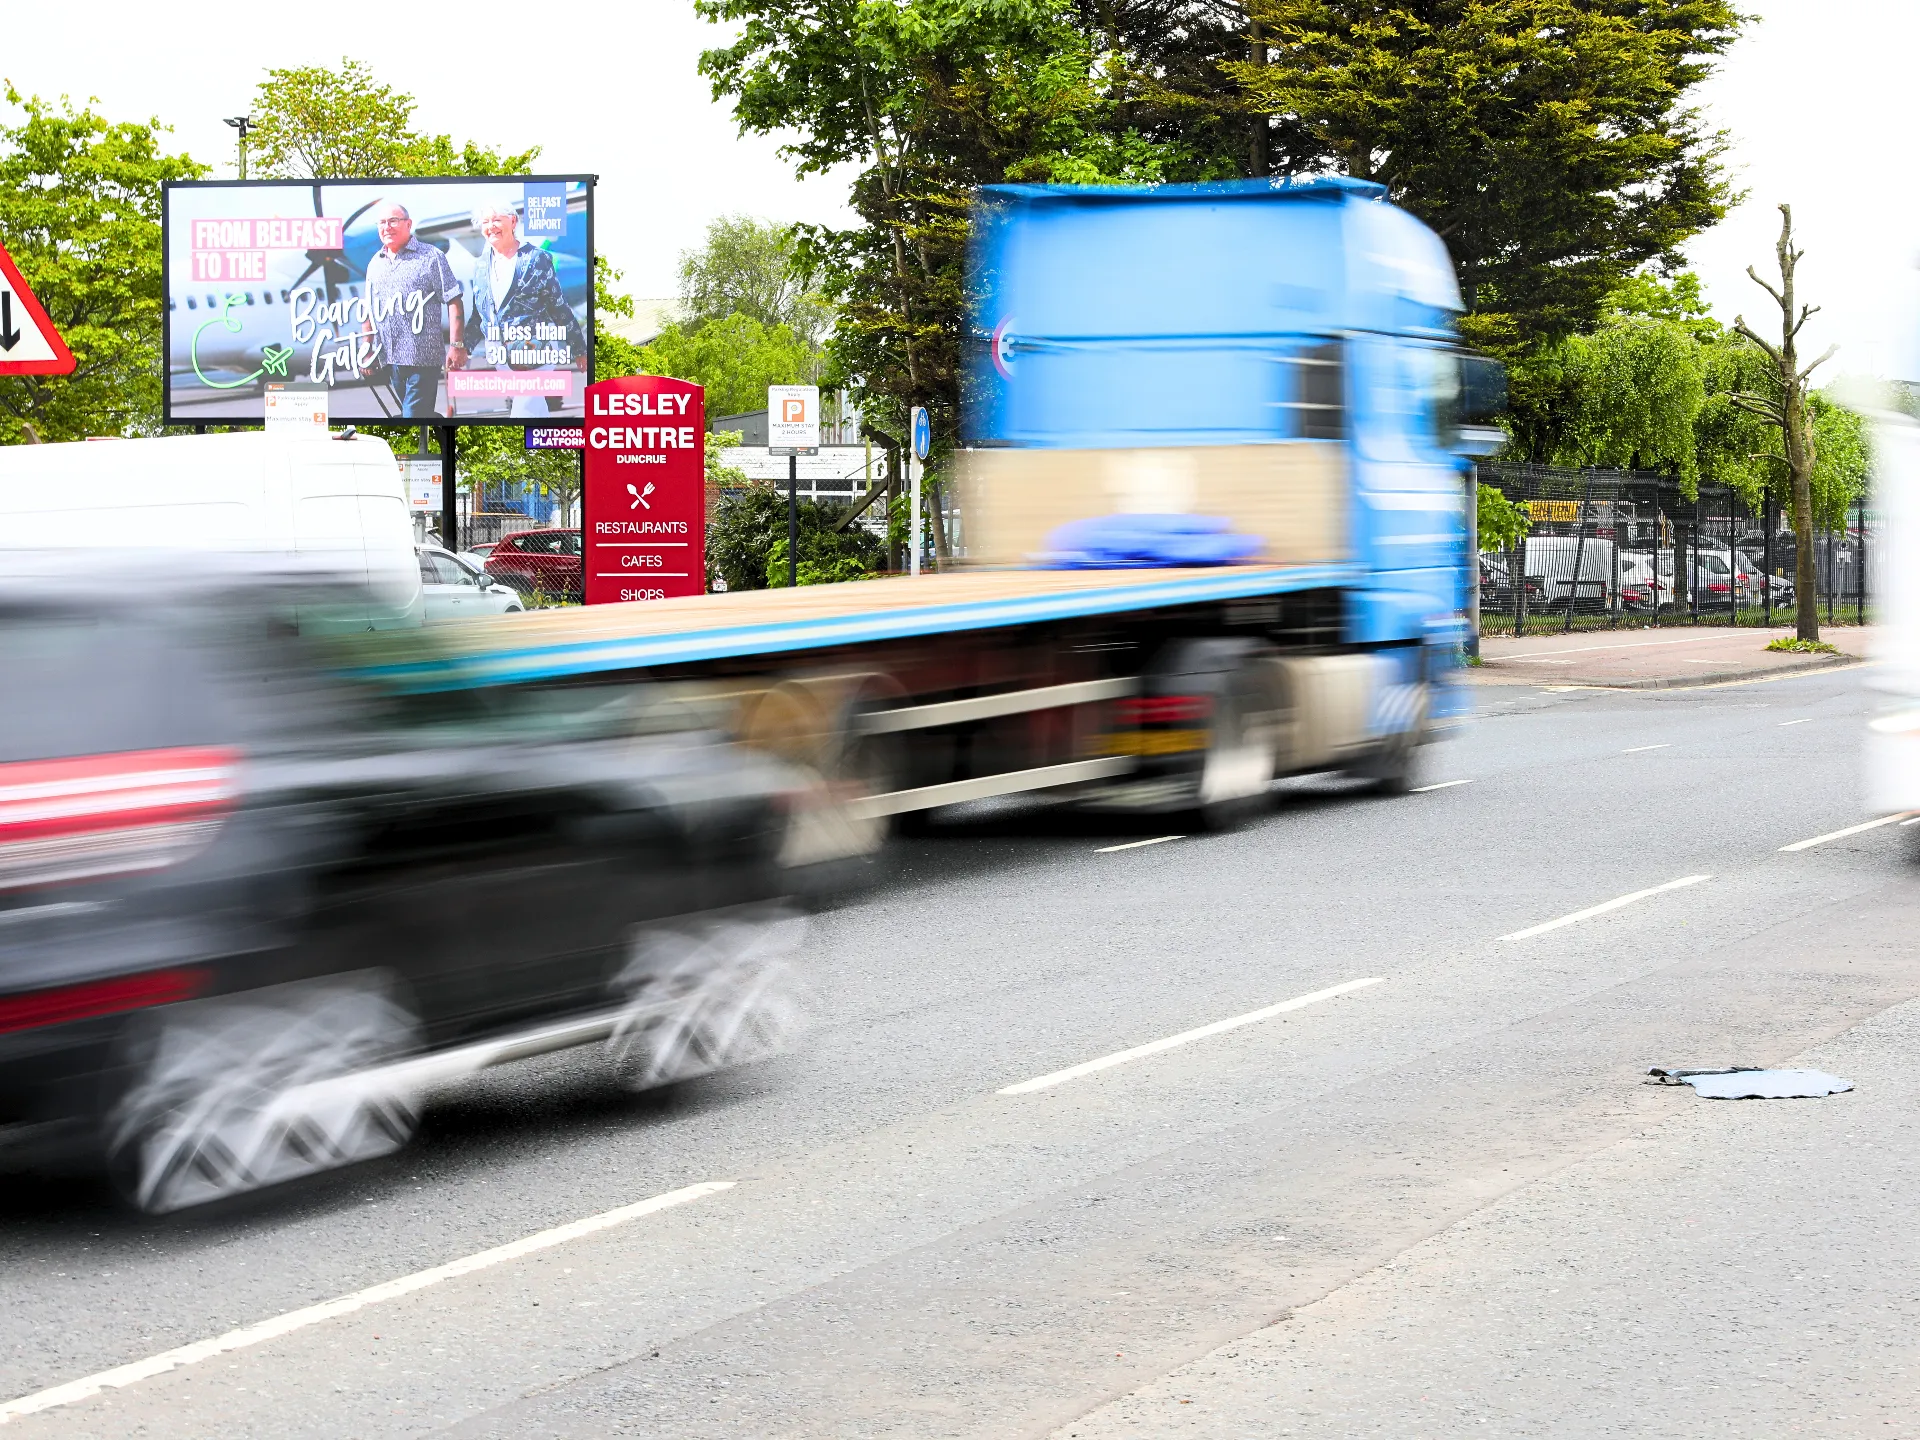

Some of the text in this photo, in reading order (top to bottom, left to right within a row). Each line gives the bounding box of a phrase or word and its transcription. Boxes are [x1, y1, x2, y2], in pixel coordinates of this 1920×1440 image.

[528, 196, 562, 208] BELFAST
[528, 207, 547, 219] CITY
[528, 218, 562, 230] AIRPORT
[196, 219, 340, 248] FROM BELFAST
[196, 251, 264, 279] TO THE
[290, 279, 436, 344] Boarding
[488, 321, 567, 341] in less than
[310, 328, 383, 387] Gate
[487, 345, 571, 365] 30 minutes!
[454, 376, 566, 393] belfastcityairport.com
[593, 393, 691, 416] LESLEY
[786, 401, 802, 421] P
[316, 413, 323, 422] 2
[532, 428, 583, 438] OUTDOOR
[589, 427, 695, 449] CENTRE
[532, 437, 586, 447] PLATFORM
[616, 455, 667, 464] DUNCRUE
[595, 521, 688, 534] RESTAURANTS
[621, 555, 663, 567] CAFES
[620, 588, 665, 601] SHOPS
